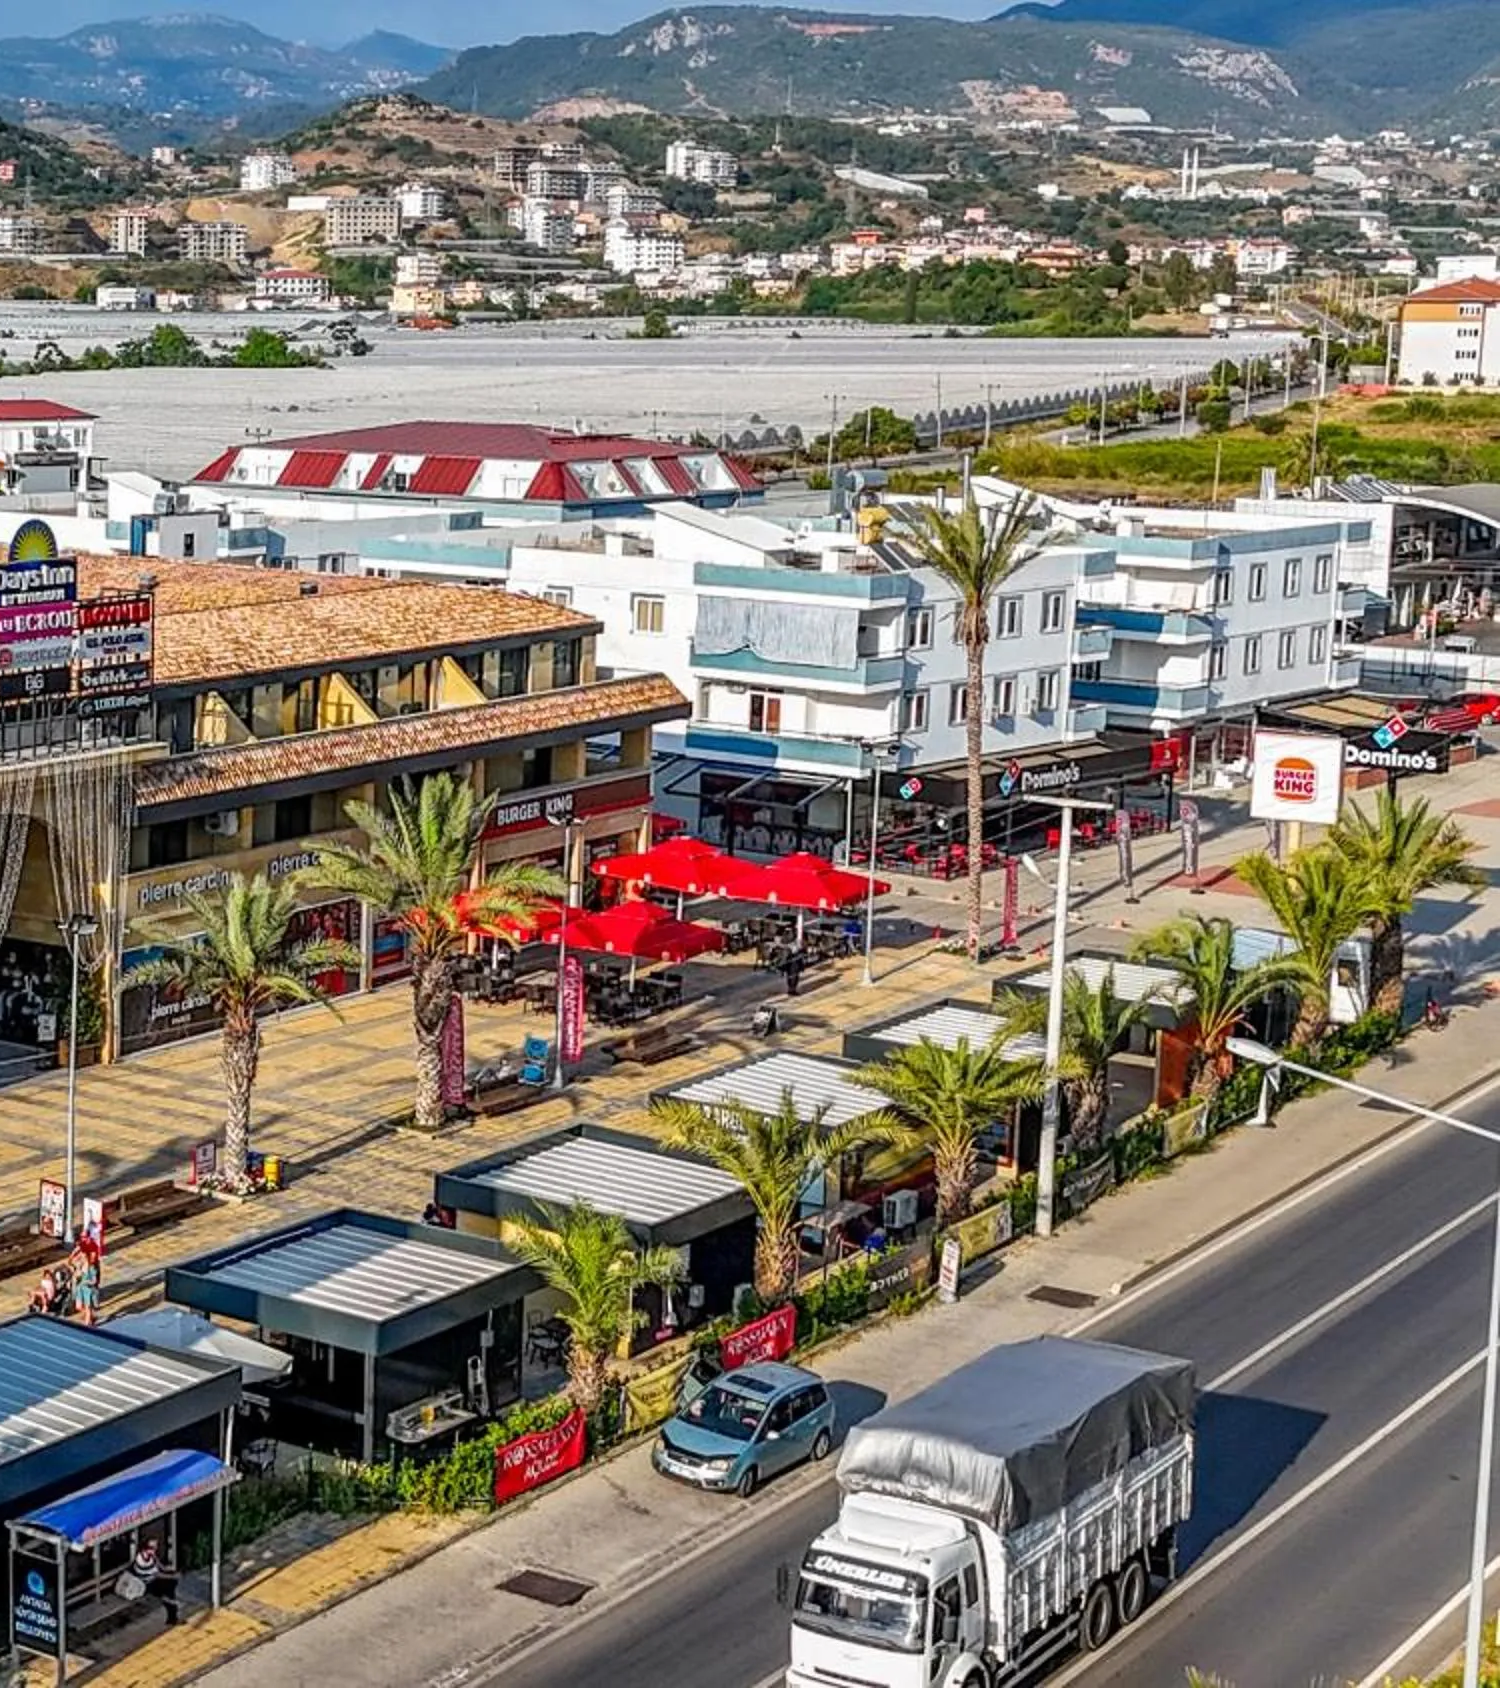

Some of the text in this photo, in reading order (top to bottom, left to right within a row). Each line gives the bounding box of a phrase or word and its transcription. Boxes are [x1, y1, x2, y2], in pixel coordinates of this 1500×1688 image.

[1345, 745, 1437, 770] Domino's
[1022, 761, 1080, 792] Domino's
[1274, 769, 1315, 780] BURGER
[1274, 780, 1314, 793] KING
[497, 794, 573, 826] BURGER KING
[269, 853, 309, 877] pierre
[139, 869, 230, 909] pierre cardin
